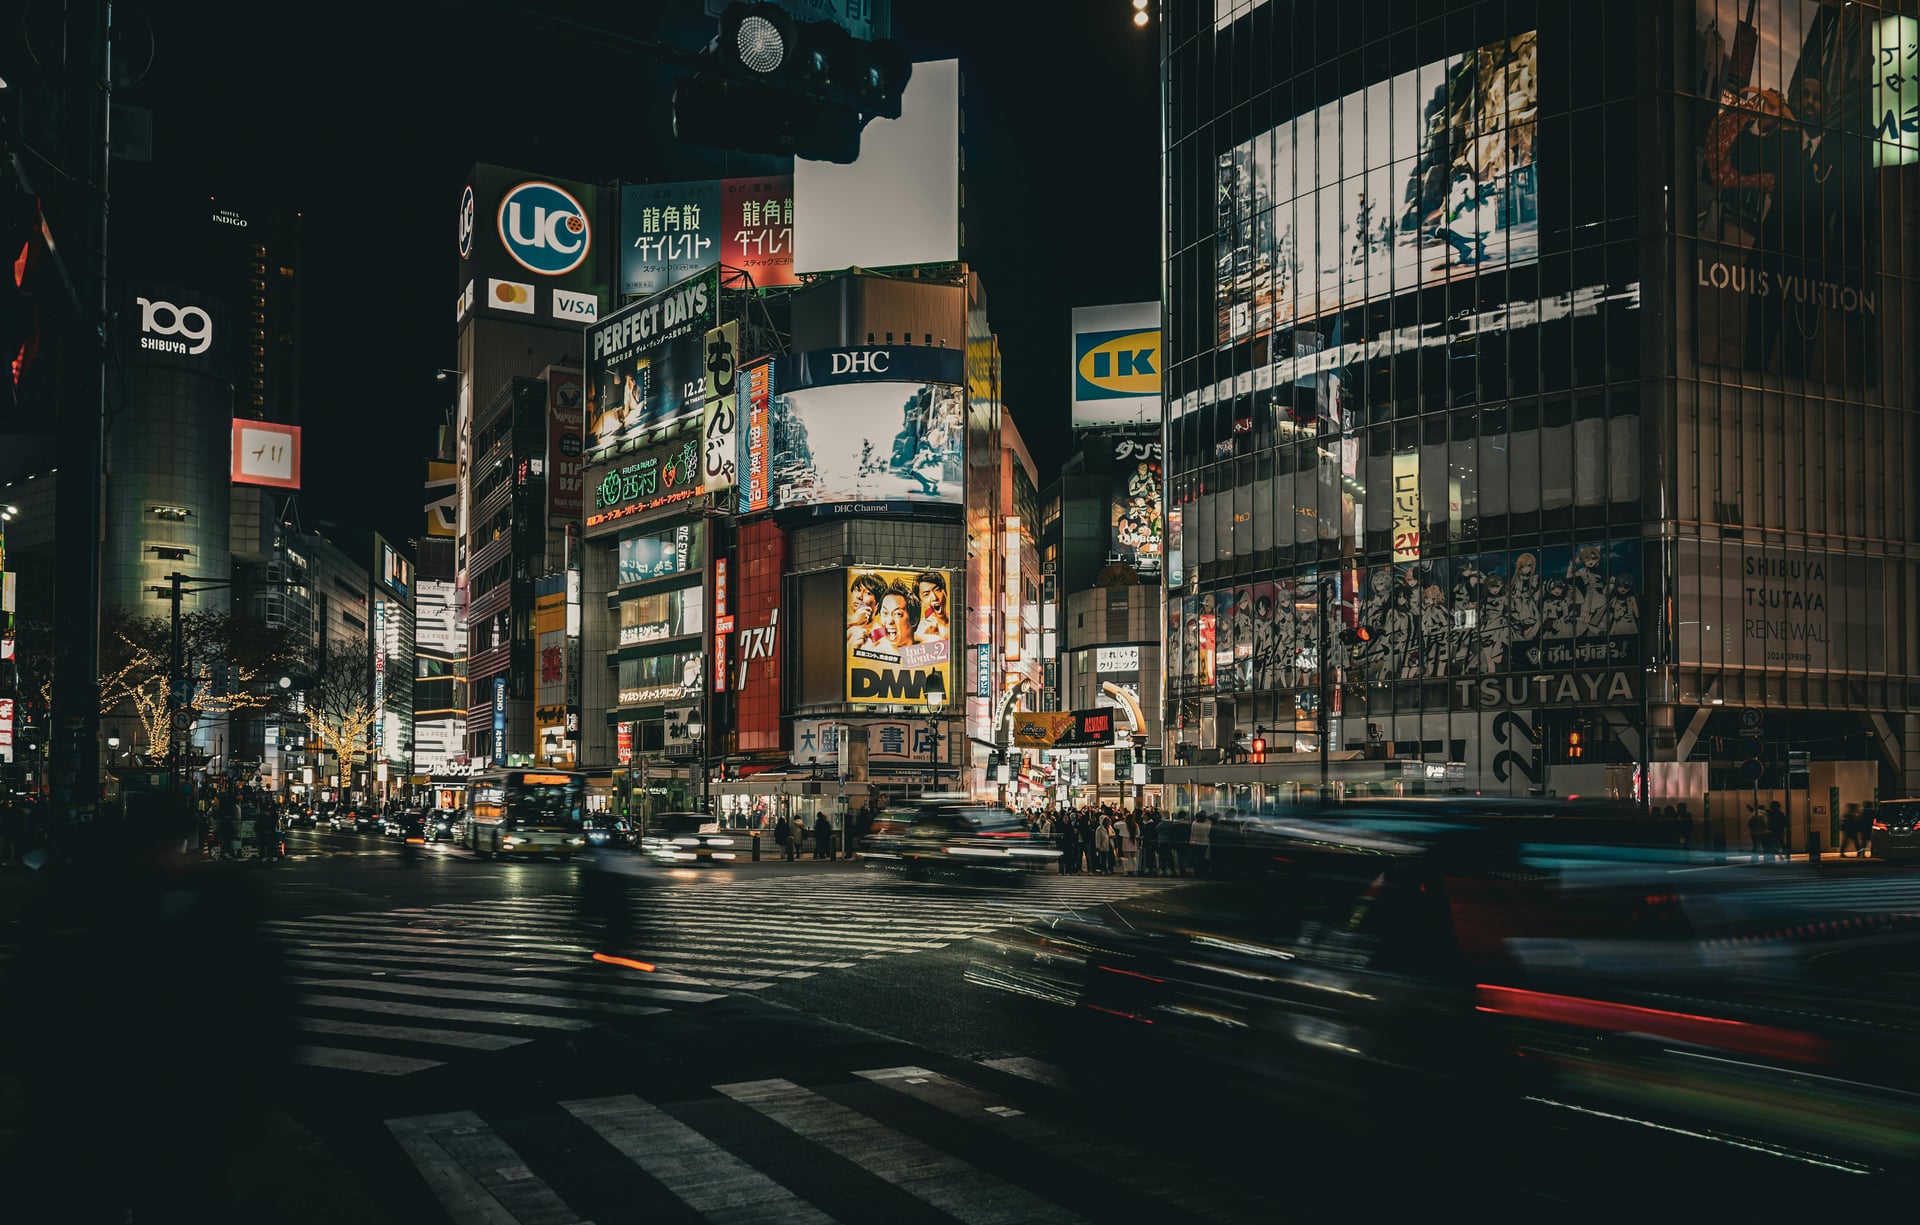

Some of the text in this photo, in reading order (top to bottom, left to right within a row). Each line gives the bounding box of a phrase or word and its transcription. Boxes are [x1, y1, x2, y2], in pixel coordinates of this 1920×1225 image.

[212, 214, 248, 228] INDIGO
[220, 210, 240, 219] HOTEL
[643, 204, 701, 233] 龍角散
[634, 234, 711, 262] ダイレクト
[1698, 259, 1875, 315] LOUIS VUITTON
[558, 297, 595, 316] VISA
[137, 297, 213, 355] 109
[594, 283, 708, 361] PERFECT DAYS
[141, 337, 187, 355] SHIBUYA
[831, 350, 890, 375] DHC
[706, 330, 736, 485] もんじゃ
[623, 468, 657, 501] 西村
[834, 503, 888, 513] DHC Channel
[1746, 556, 1825, 581] SHIBUYA
[417, 584, 431, 592] TAX
[1746, 588, 1825, 611] TSUTAYA
[417, 608, 431, 616] TAX
[417, 632, 431, 640] TAX
[740, 625, 777, 660] クスリ
[1099, 661, 1137, 670] クリニック
[1101, 651, 1137, 659] れいわ
[1767, 652, 1812, 662] 2024 SPRING
[1456, 673, 1633, 707] TSUTAYA
[799, 726, 937, 754] 大盛書店
